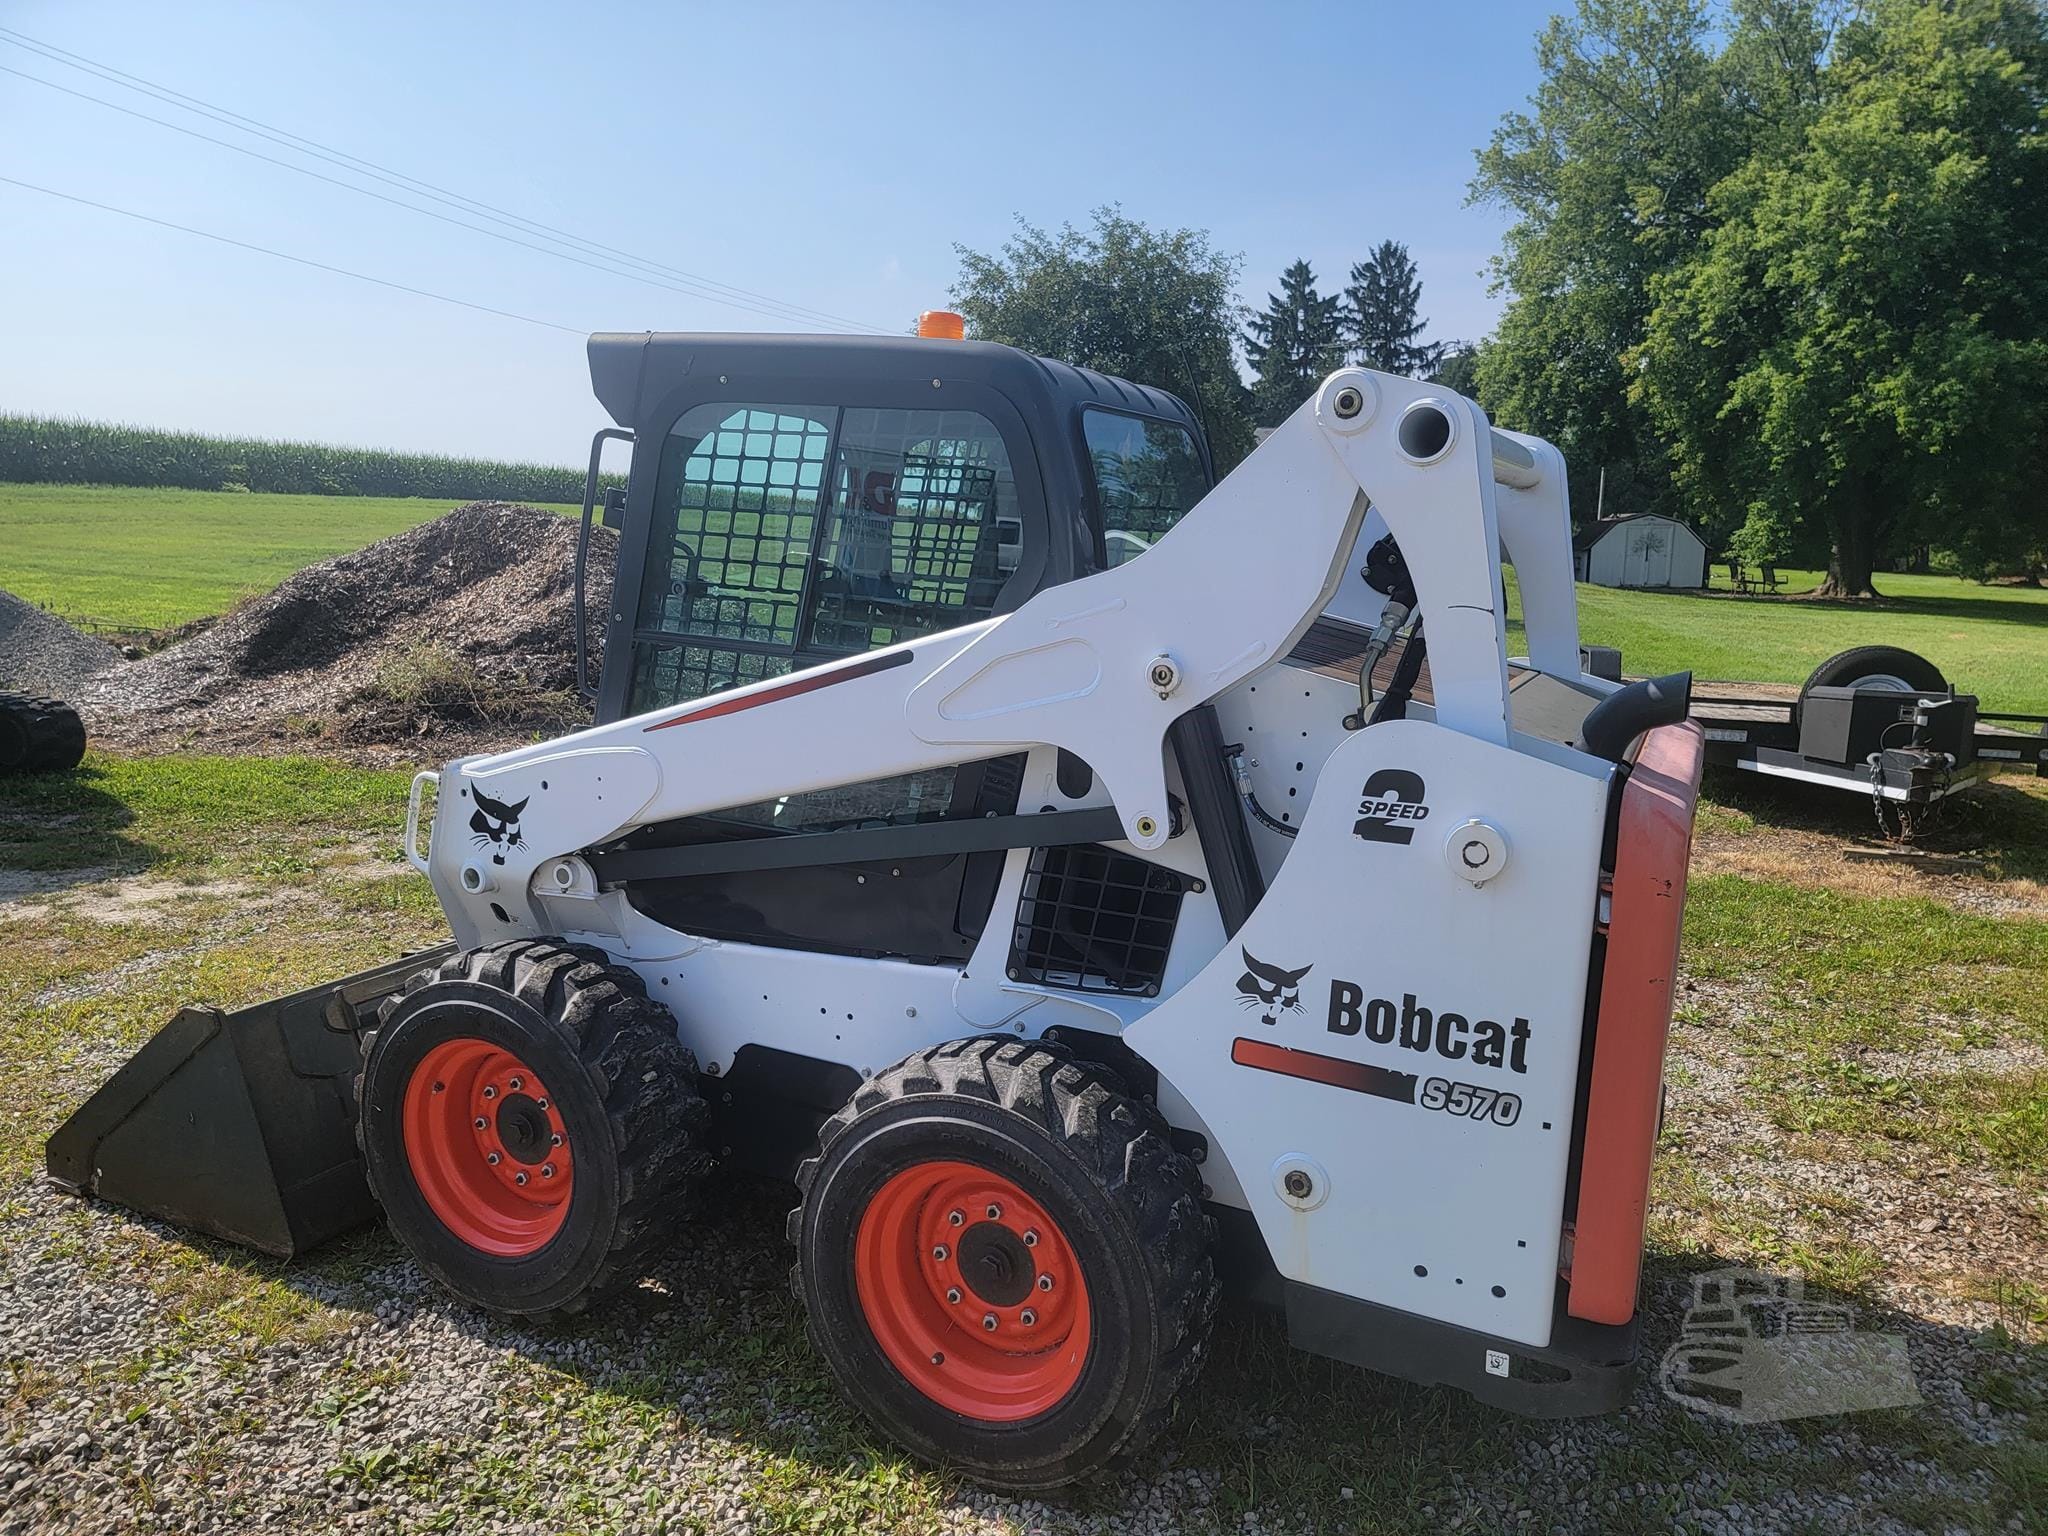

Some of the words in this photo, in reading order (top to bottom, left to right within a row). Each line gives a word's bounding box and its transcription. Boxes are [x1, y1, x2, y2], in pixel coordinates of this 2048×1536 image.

[1352, 769, 1426, 845] 2
[1357, 800, 1430, 820] SPEED
[1327, 978, 1532, 1074] Bobcat
[1420, 1077, 1523, 1127] S570
